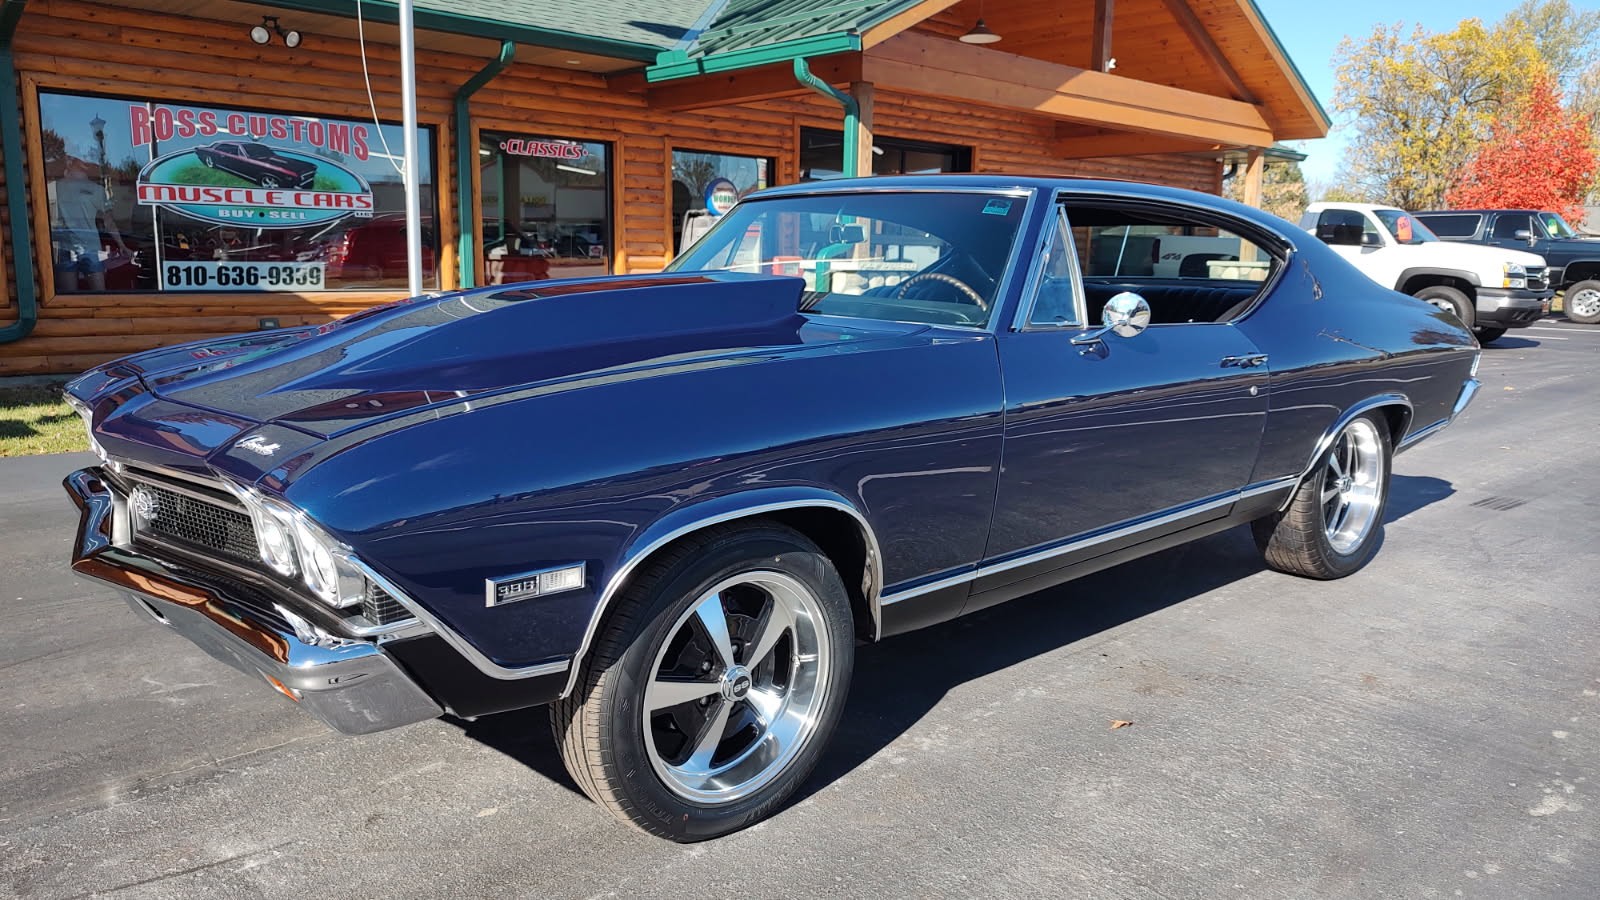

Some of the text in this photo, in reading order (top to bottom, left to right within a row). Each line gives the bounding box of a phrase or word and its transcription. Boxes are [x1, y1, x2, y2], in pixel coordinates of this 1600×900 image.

[129, 105, 370, 162] ROSS CUSTOMS
[506, 139, 583, 160] CLASSICS
[138, 185, 373, 209] MUSCLE CARS
[218, 209, 307, 220] BUY SELL
